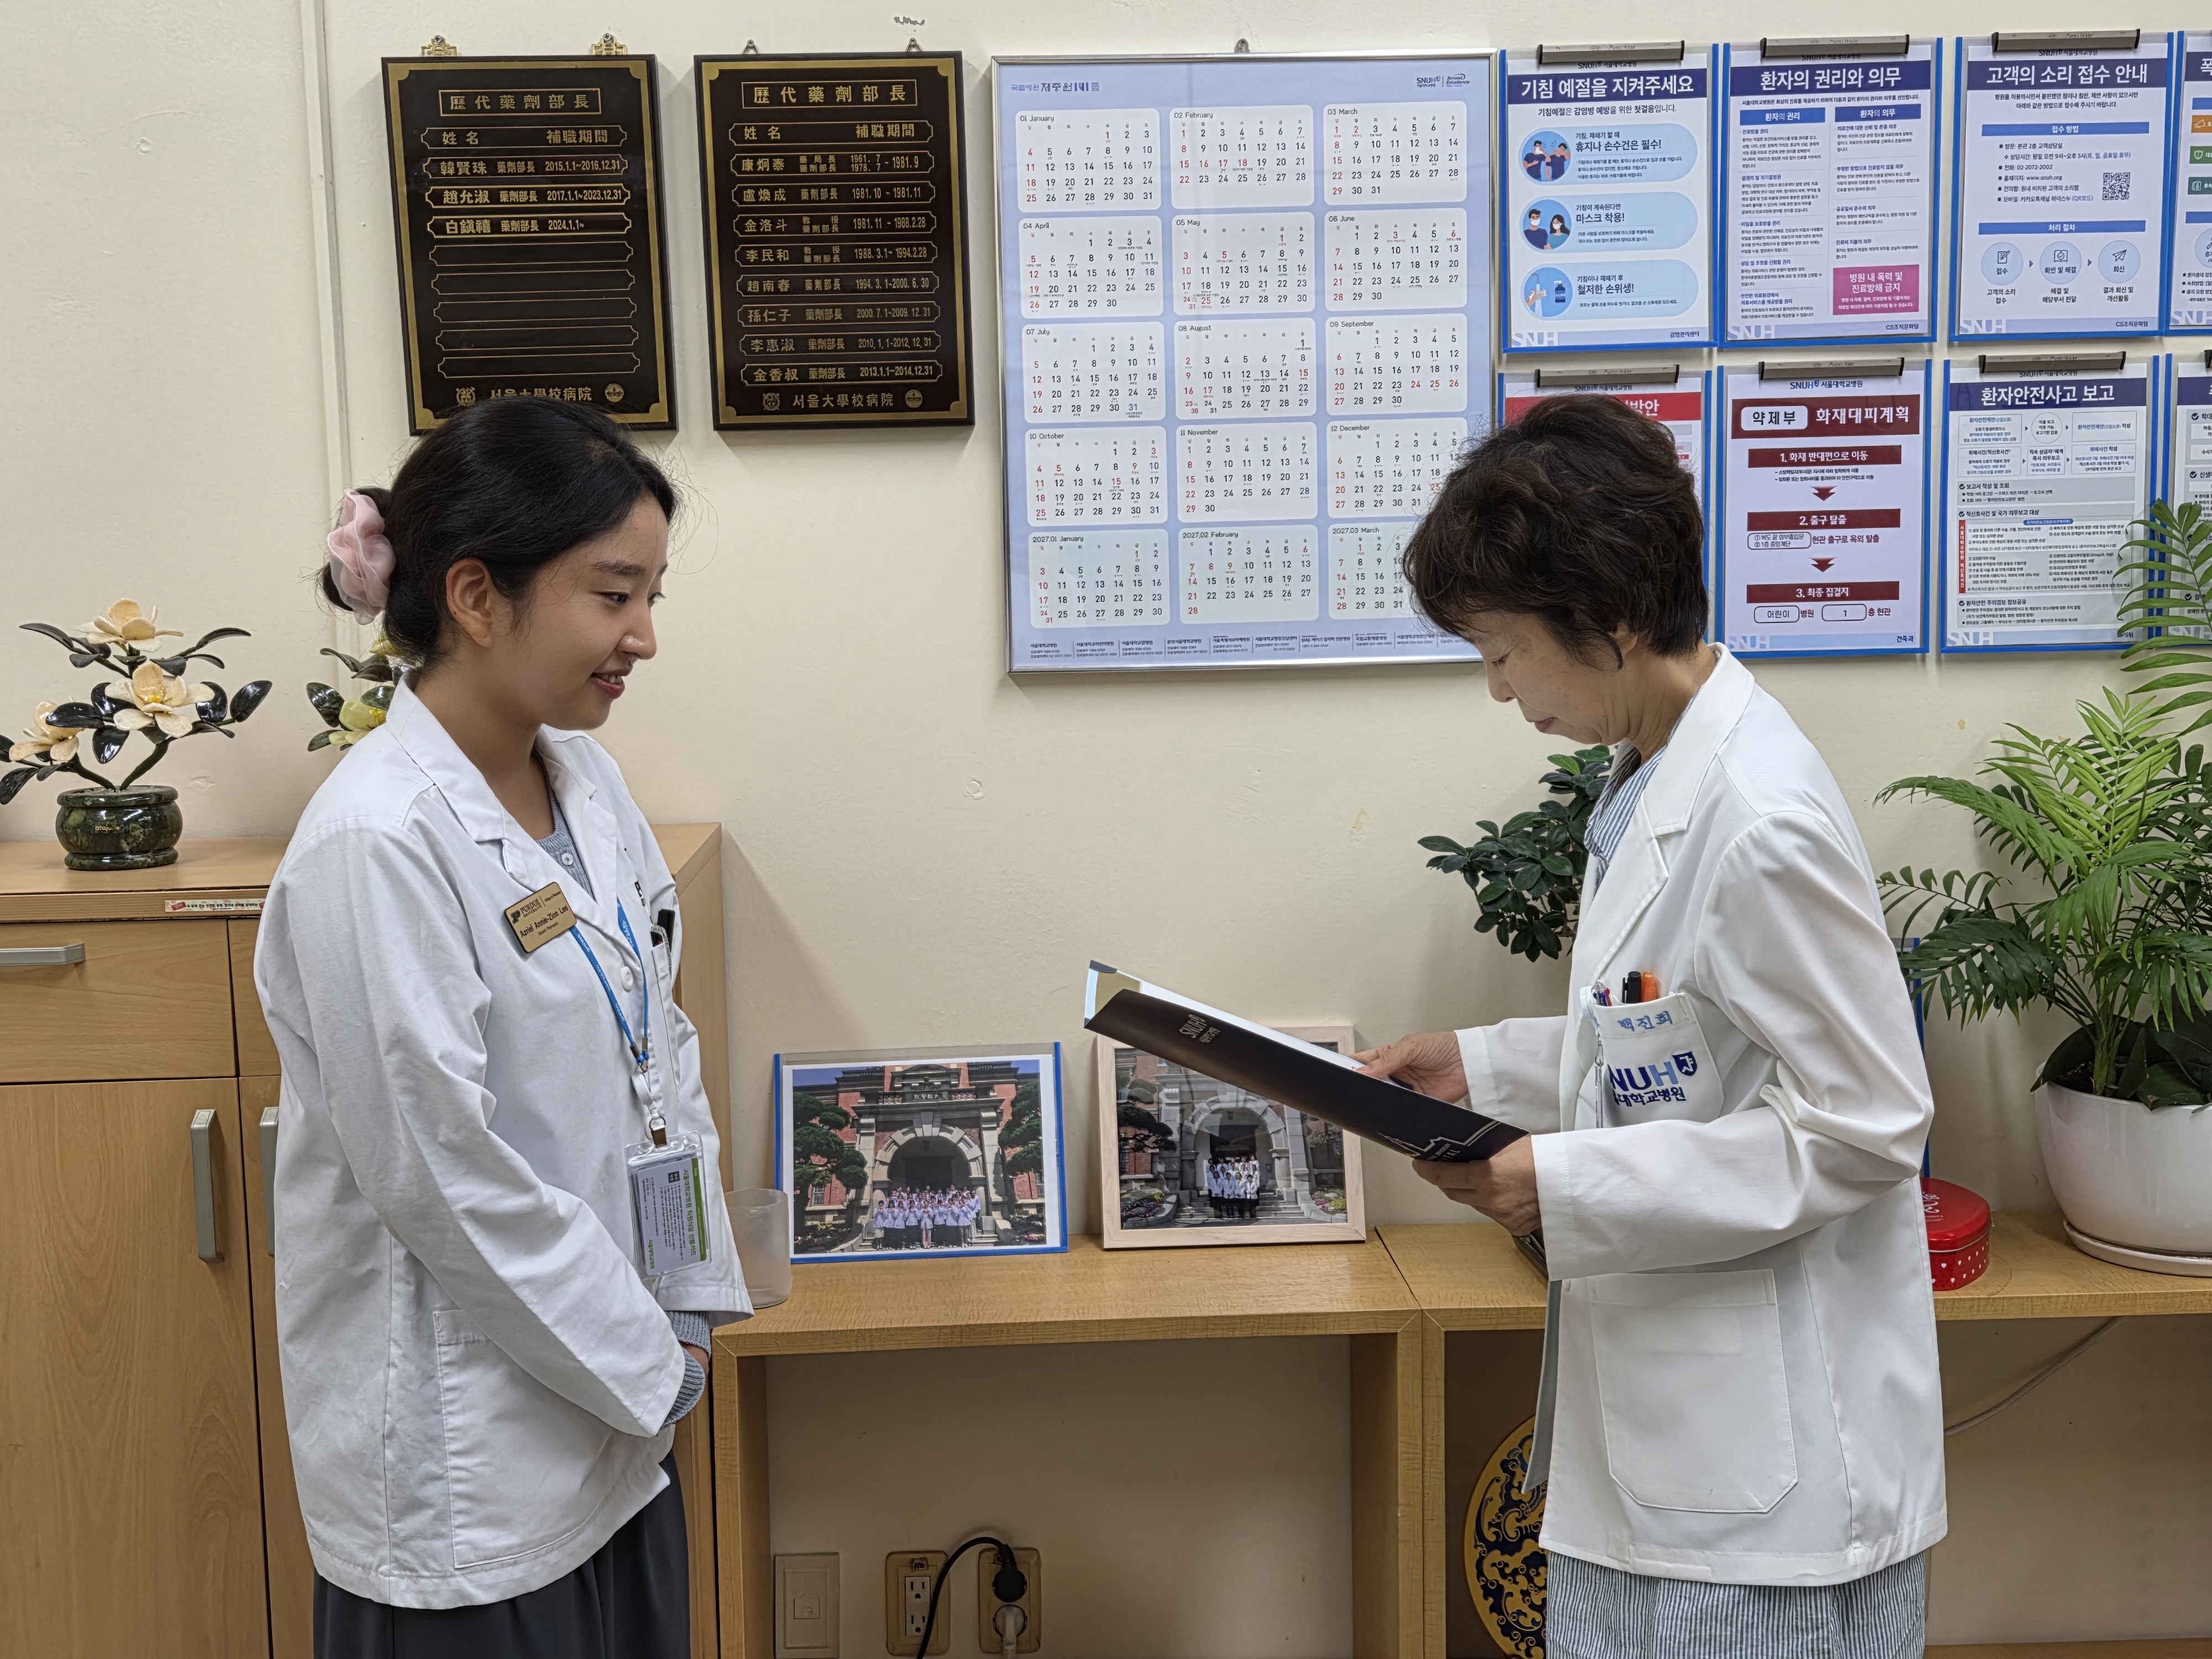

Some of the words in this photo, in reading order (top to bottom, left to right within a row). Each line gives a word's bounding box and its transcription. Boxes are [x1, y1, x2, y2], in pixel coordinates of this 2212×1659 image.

[1761, 70, 1809, 91] 환자의
[1814, 68, 1863, 88] 권리와
[1868, 67, 1901, 87] 의무
[1987, 65, 2034, 85] 고객의
[2041, 65, 2072, 84] 소리
[2078, 65, 2110, 84] 접수
[2115, 64, 2147, 84] 안내
[1522, 80, 1553, 100] 기침
[1559, 78, 1608, 98] 예절을
[1613, 75, 1694, 96] 지켜주세요
[1538, 107, 1572, 117] 기침예절은
[1574, 107, 1594, 116] 감염병
[1596, 107, 1617, 115] 예방을
[1635, 104, 1676, 113] 첫걸음입니다.
[1765, 113, 1785, 121] 환자의
[1787, 112, 1800, 121] 권리
[442, 131, 478, 145] 姓名
[547, 129, 608, 143] 補職期間
[744, 126, 780, 139] 姓名
[855, 124, 914, 138] 補職期間
[1575, 141, 1601, 153] 휴지나
[1604, 140, 1639, 152] 손수건은
[1641, 140, 1661, 150] 필수!
[440, 161, 487, 175] 韓賢珠
[497, 161, 535, 173] 藥劑部長
[545, 160, 620, 171] 2015.1.1~2016.12.31
[444, 190, 489, 204] 趙允淑
[499, 190, 538, 202] 藥劑部長
[547, 190, 622, 201] 2017.1.1~2023.12.31
[549, 220, 584, 230] 2024.1.1~
[894, 217, 926, 228] 1988.2.28
[1576, 214, 1603, 224] 마스크
[1605, 213, 1625, 222] 착용!
[747, 249, 789, 262] 李民和
[1850, 273, 1866, 283] 병원
[1867, 273, 1875, 282] 내
[1894, 272, 1902, 281] 및
[747, 279, 790, 291] 趙南春
[1578, 285, 1603, 295] 철저한
[1605, 284, 1634, 294] 손위생!
[1852, 284, 1882, 293] 진료방해
[1885, 283, 1900, 292] 금지
[748, 309, 791, 322] 孫仁子
[860, 366, 932, 377] 2013.1.1~2014.12.31
[793, 393, 894, 408] 서울大學校病院
[1981, 385, 2077, 406] 환자안전사고
[2082, 385, 2115, 401] 보고
[1752, 411, 1796, 425] 약제부
[1817, 406, 1908, 424] 화재대피계획
[1780, 453, 1787, 462] 1.
[1790, 452, 1806, 461] 화재
[1809, 452, 1849, 461] 반대편으로
[1851, 451, 1868, 460] 이동
[1799, 516, 1808, 525] 2.
[1811, 515, 1828, 525] 출구
[1830, 515, 1847, 525] 탈출
[1812, 536, 1825, 544] 현관
[1828, 535, 1848, 544] 출구로
[1866, 534, 1880, 542] 탈출
[1796, 589, 1805, 597] 3.
[1807, 588, 1824, 597] 최종
[1826, 588, 1849, 597] 집결지
[520, 899, 540, 914] PURDUE
[523, 905, 542, 917] UNIVERSITY
[520, 925, 534, 937] Azriel
[535, 911, 559, 929] Annie-Zion
[559, 905, 568, 914] Lee
[1613, 1086, 1686, 1106] 대학교병원
